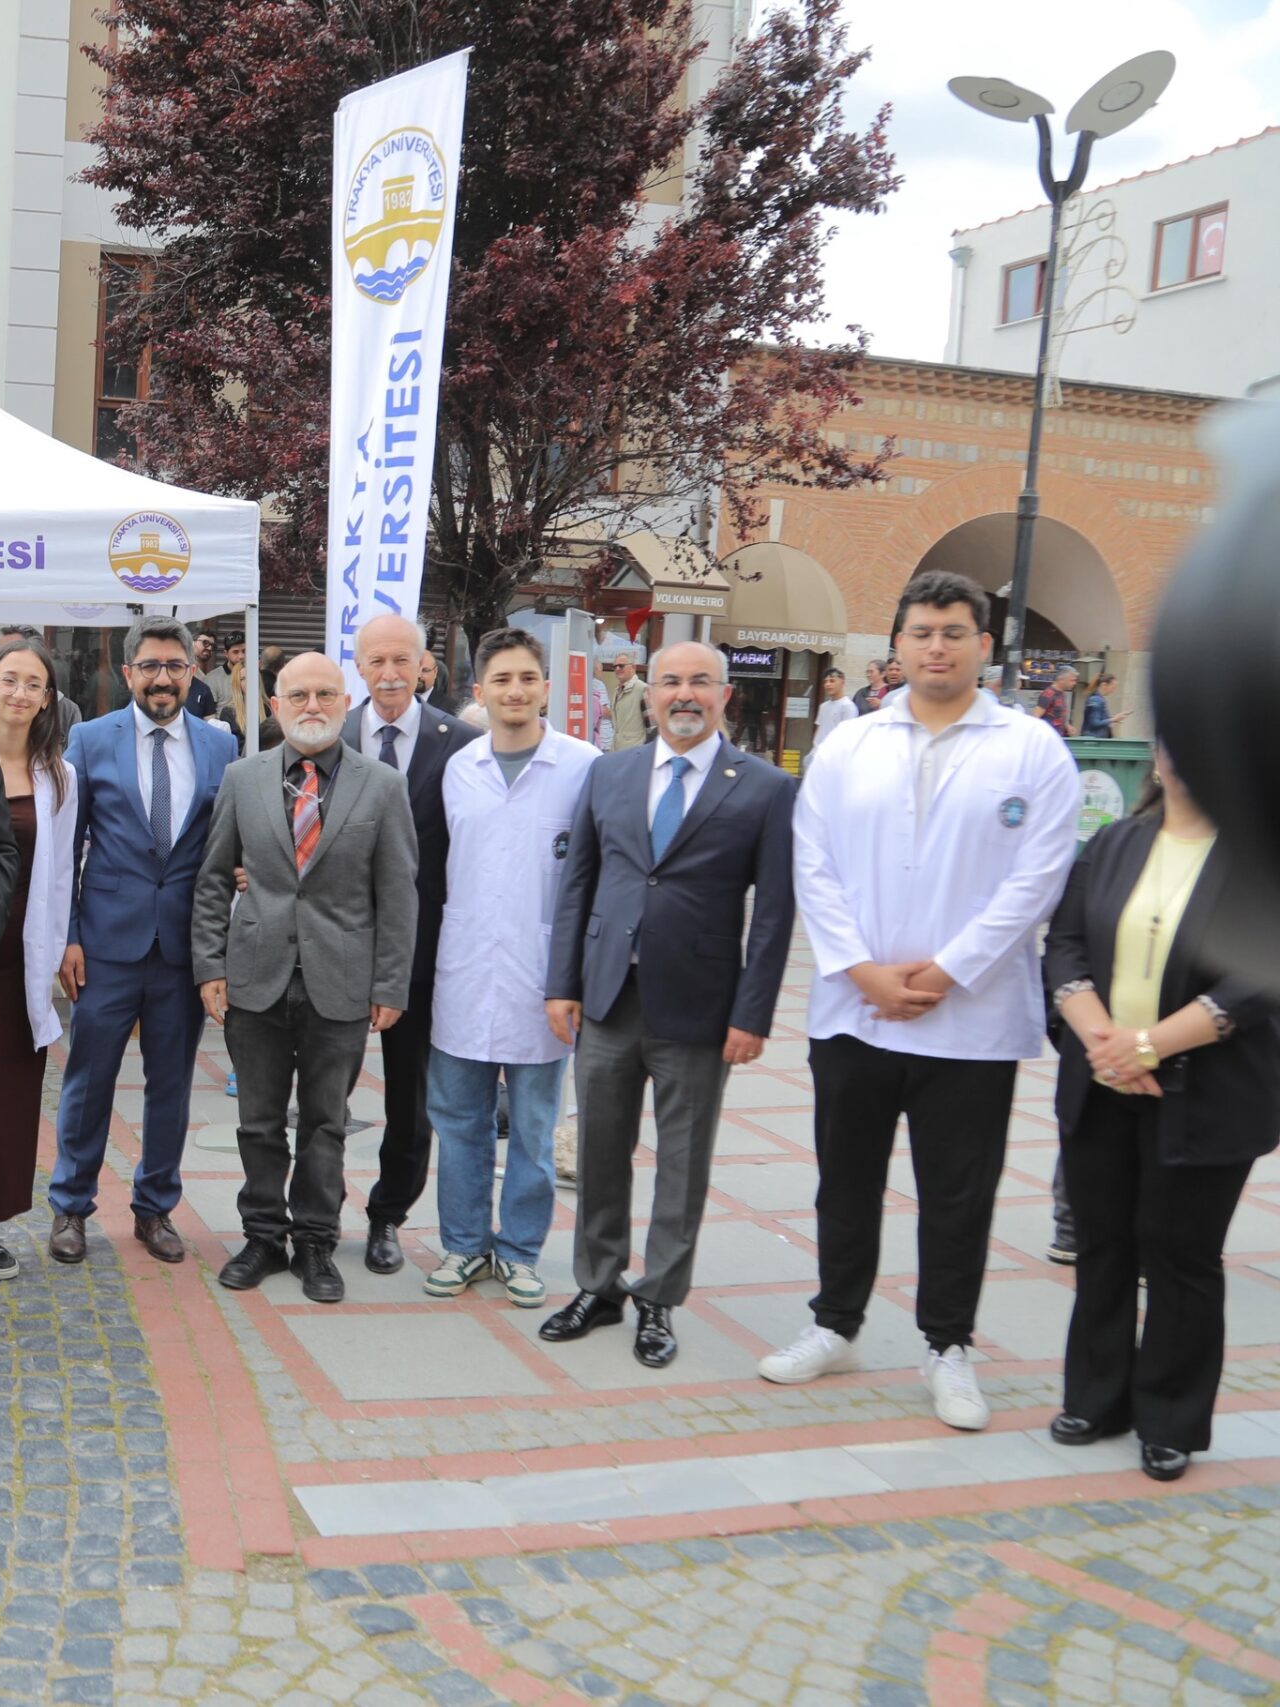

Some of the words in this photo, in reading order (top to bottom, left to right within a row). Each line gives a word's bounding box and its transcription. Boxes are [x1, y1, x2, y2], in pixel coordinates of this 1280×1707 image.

[347, 154, 382, 223] TRAKYA
[384, 191, 412, 211] 1982
[112, 518, 139, 549] TRAKYA
[139, 513, 189, 552] ÜNİVERSİTESİ
[655, 592, 692, 605] VOLKAN
[692, 596, 725, 608] METRO
[737, 629, 818, 645] BAYRAMOĞLU
[732, 652, 772, 665] KABAK
